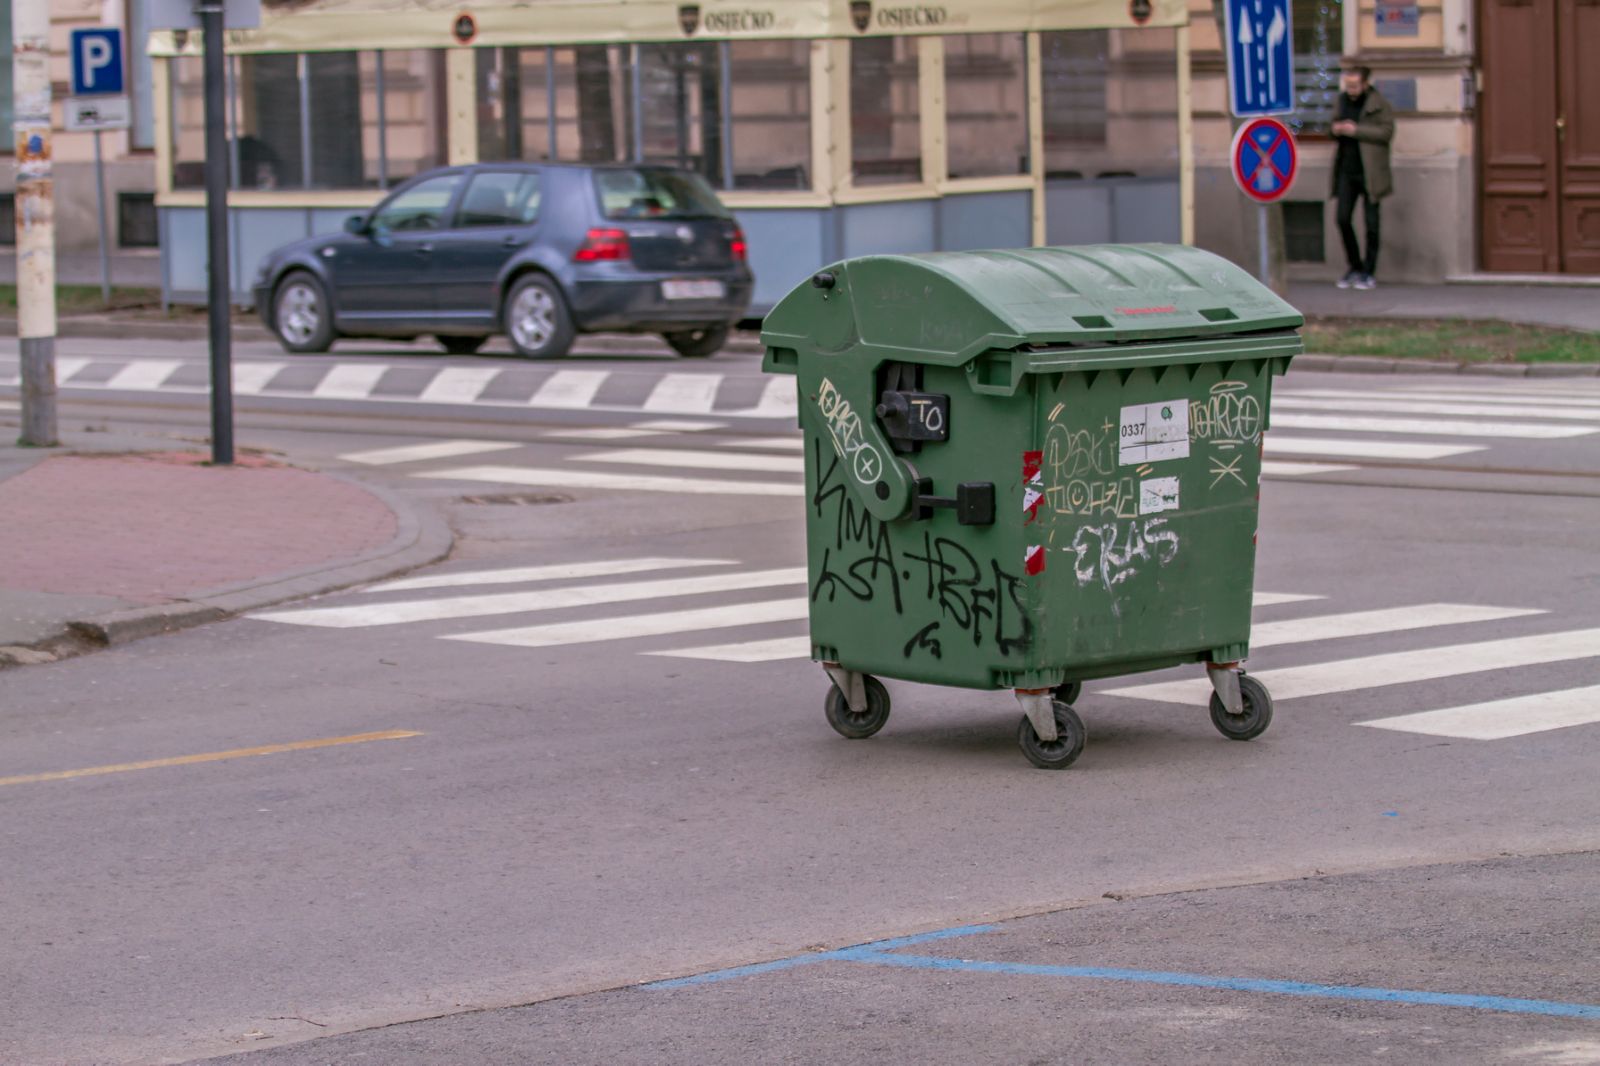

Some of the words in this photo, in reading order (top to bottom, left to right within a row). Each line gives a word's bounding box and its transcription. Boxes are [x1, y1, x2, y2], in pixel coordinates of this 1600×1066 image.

[81, 36, 113, 88] P
[911, 400, 943, 431] TO
[1121, 422, 1146, 438] 0337
